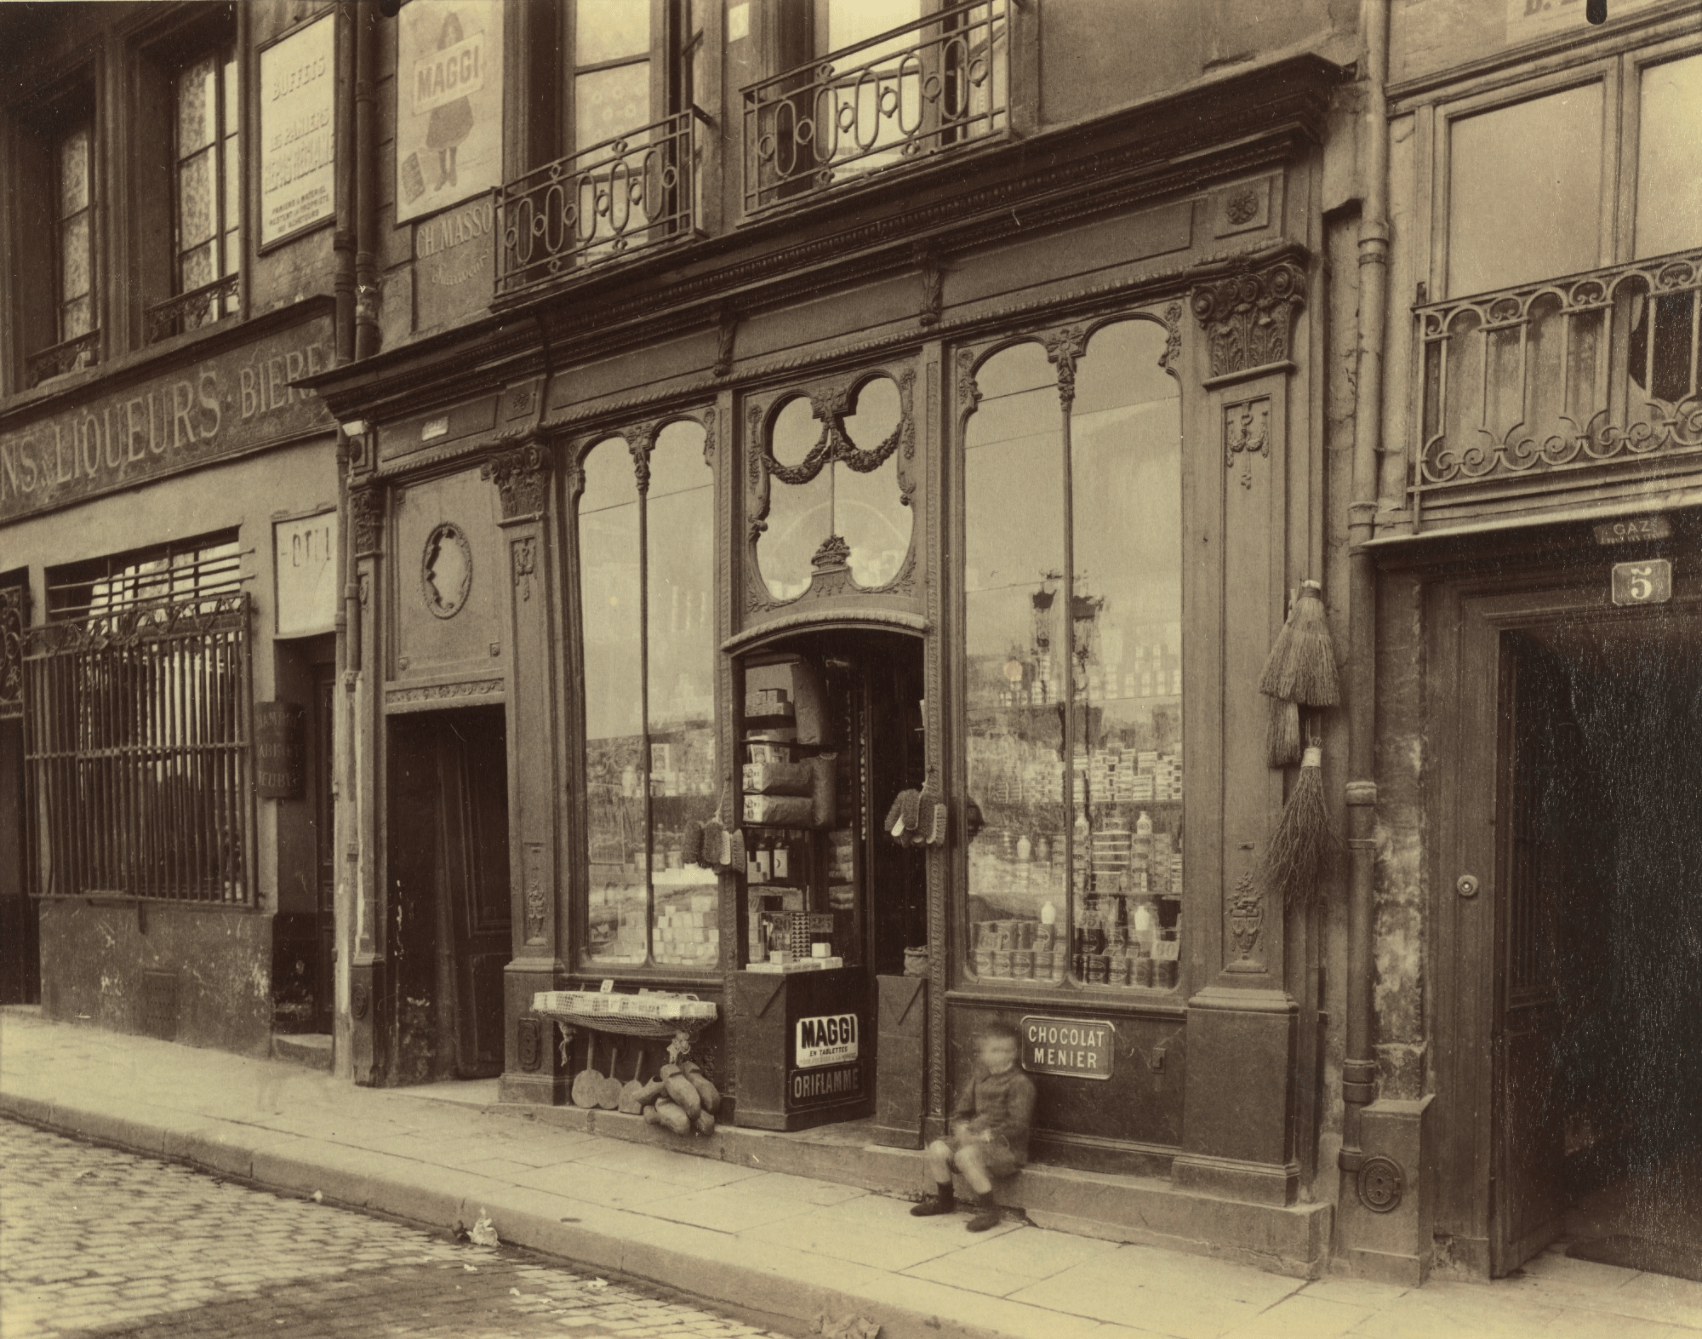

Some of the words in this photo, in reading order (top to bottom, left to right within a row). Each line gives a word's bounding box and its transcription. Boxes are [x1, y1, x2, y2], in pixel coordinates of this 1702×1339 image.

[272, 55, 326, 101] BUFFETS
[418, 45, 479, 101] MAGGI
[53, 371, 221, 484] LIQUEURS
[1612, 520, 1652, 536] GAZ
[1630, 567, 1652, 600] 5
[801, 1015, 856, 1049] MAGGI
[1028, 1025, 1105, 1048] CHOCOLAT
[820, 1046, 848, 1056] TABLETTES
[1034, 1047, 1097, 1069] MENIER
[794, 1068, 859, 1098] ORIFLAMME
